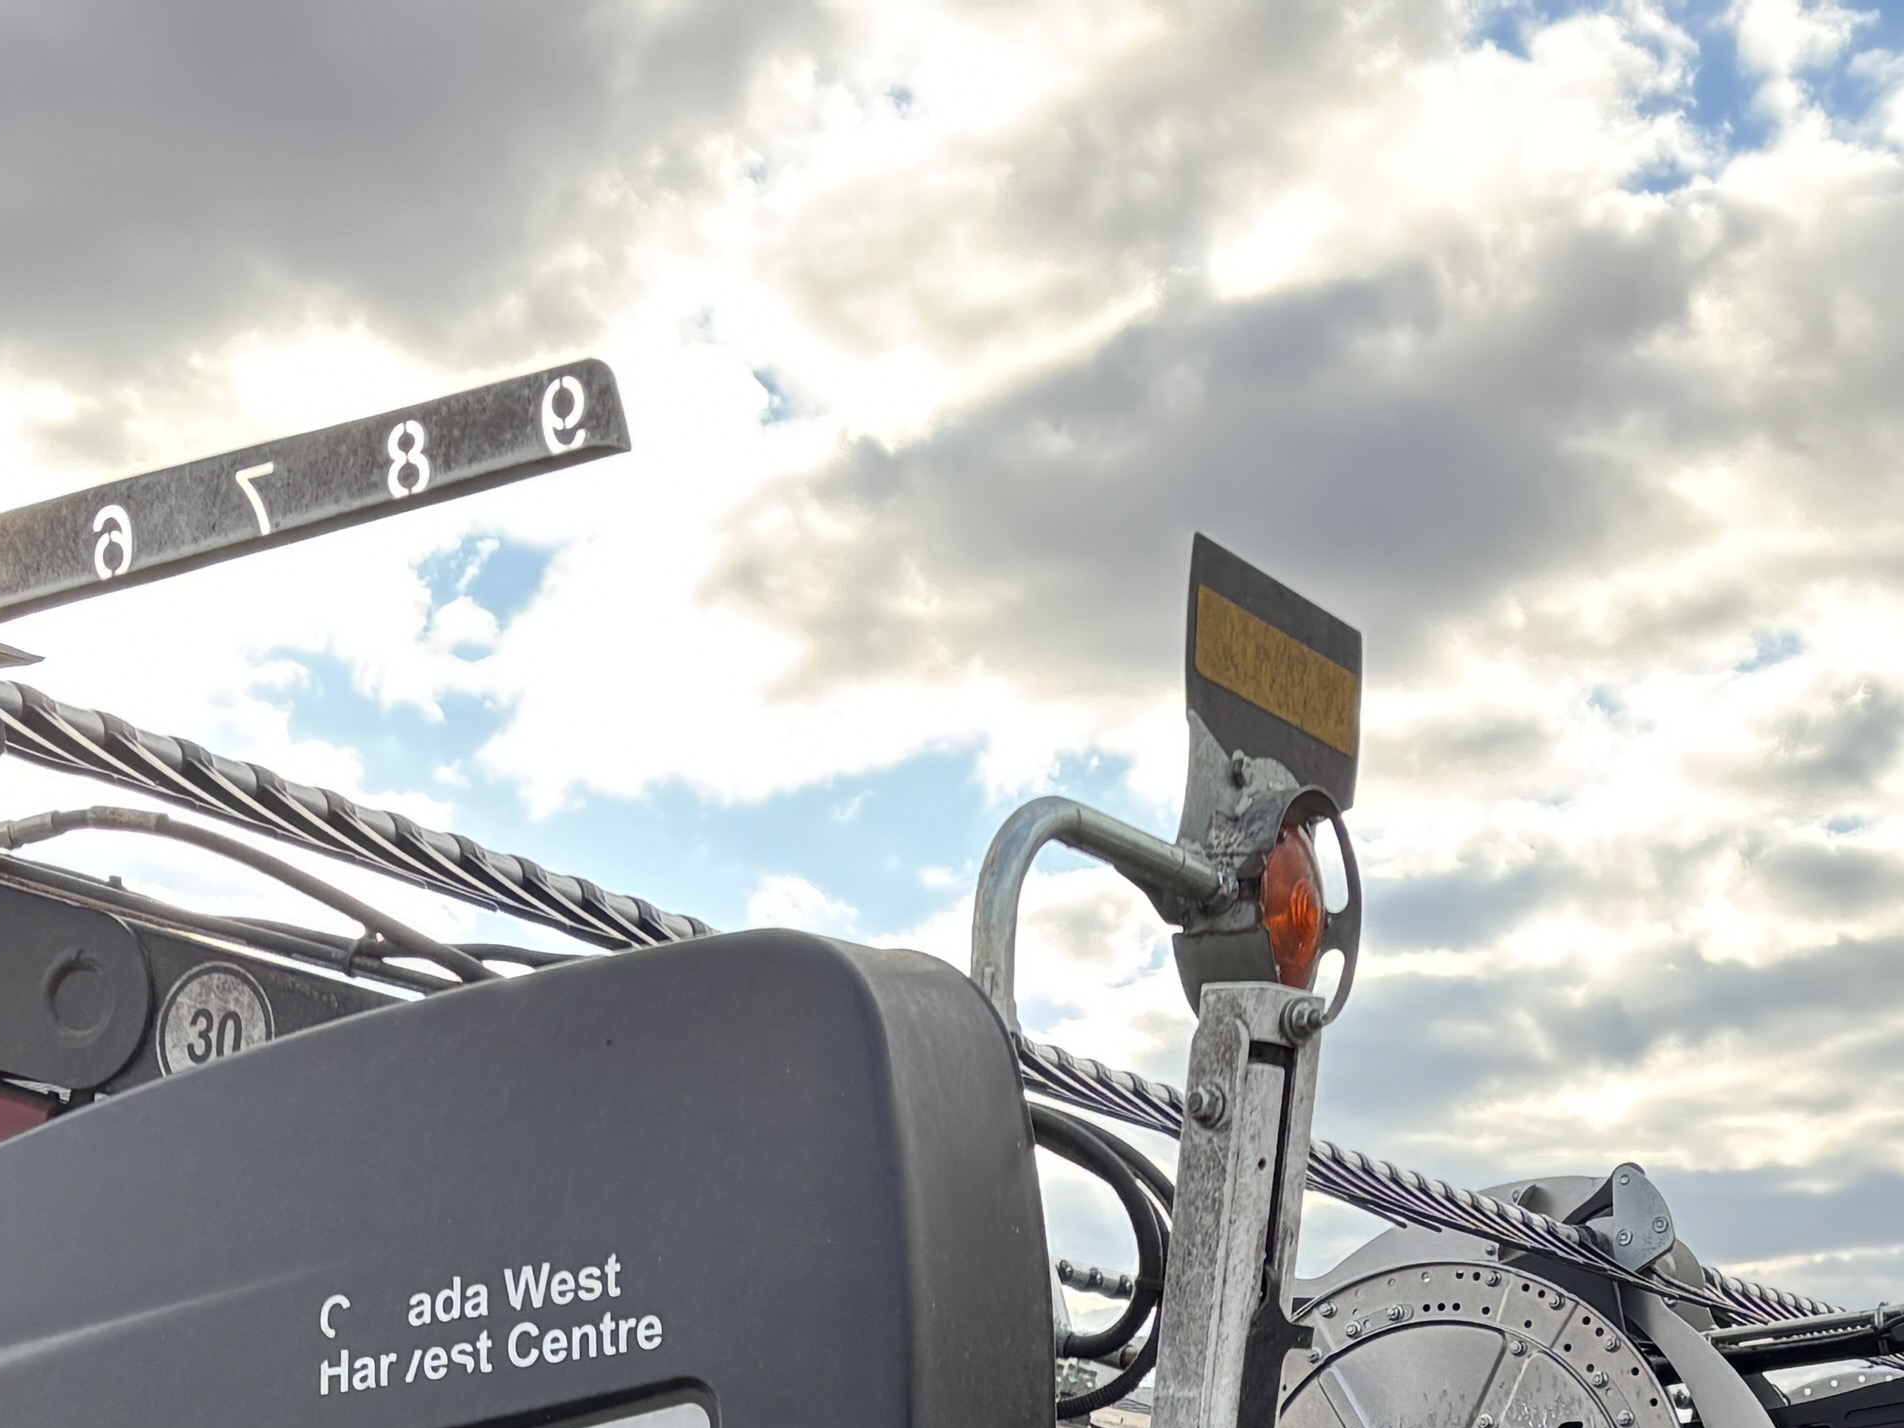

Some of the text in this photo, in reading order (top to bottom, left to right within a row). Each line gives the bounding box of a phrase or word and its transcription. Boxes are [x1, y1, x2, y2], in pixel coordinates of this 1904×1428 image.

[186, 1007, 244, 1065] 30
[503, 1252, 622, 1311] West
[506, 1312, 664, 1368] Centre
